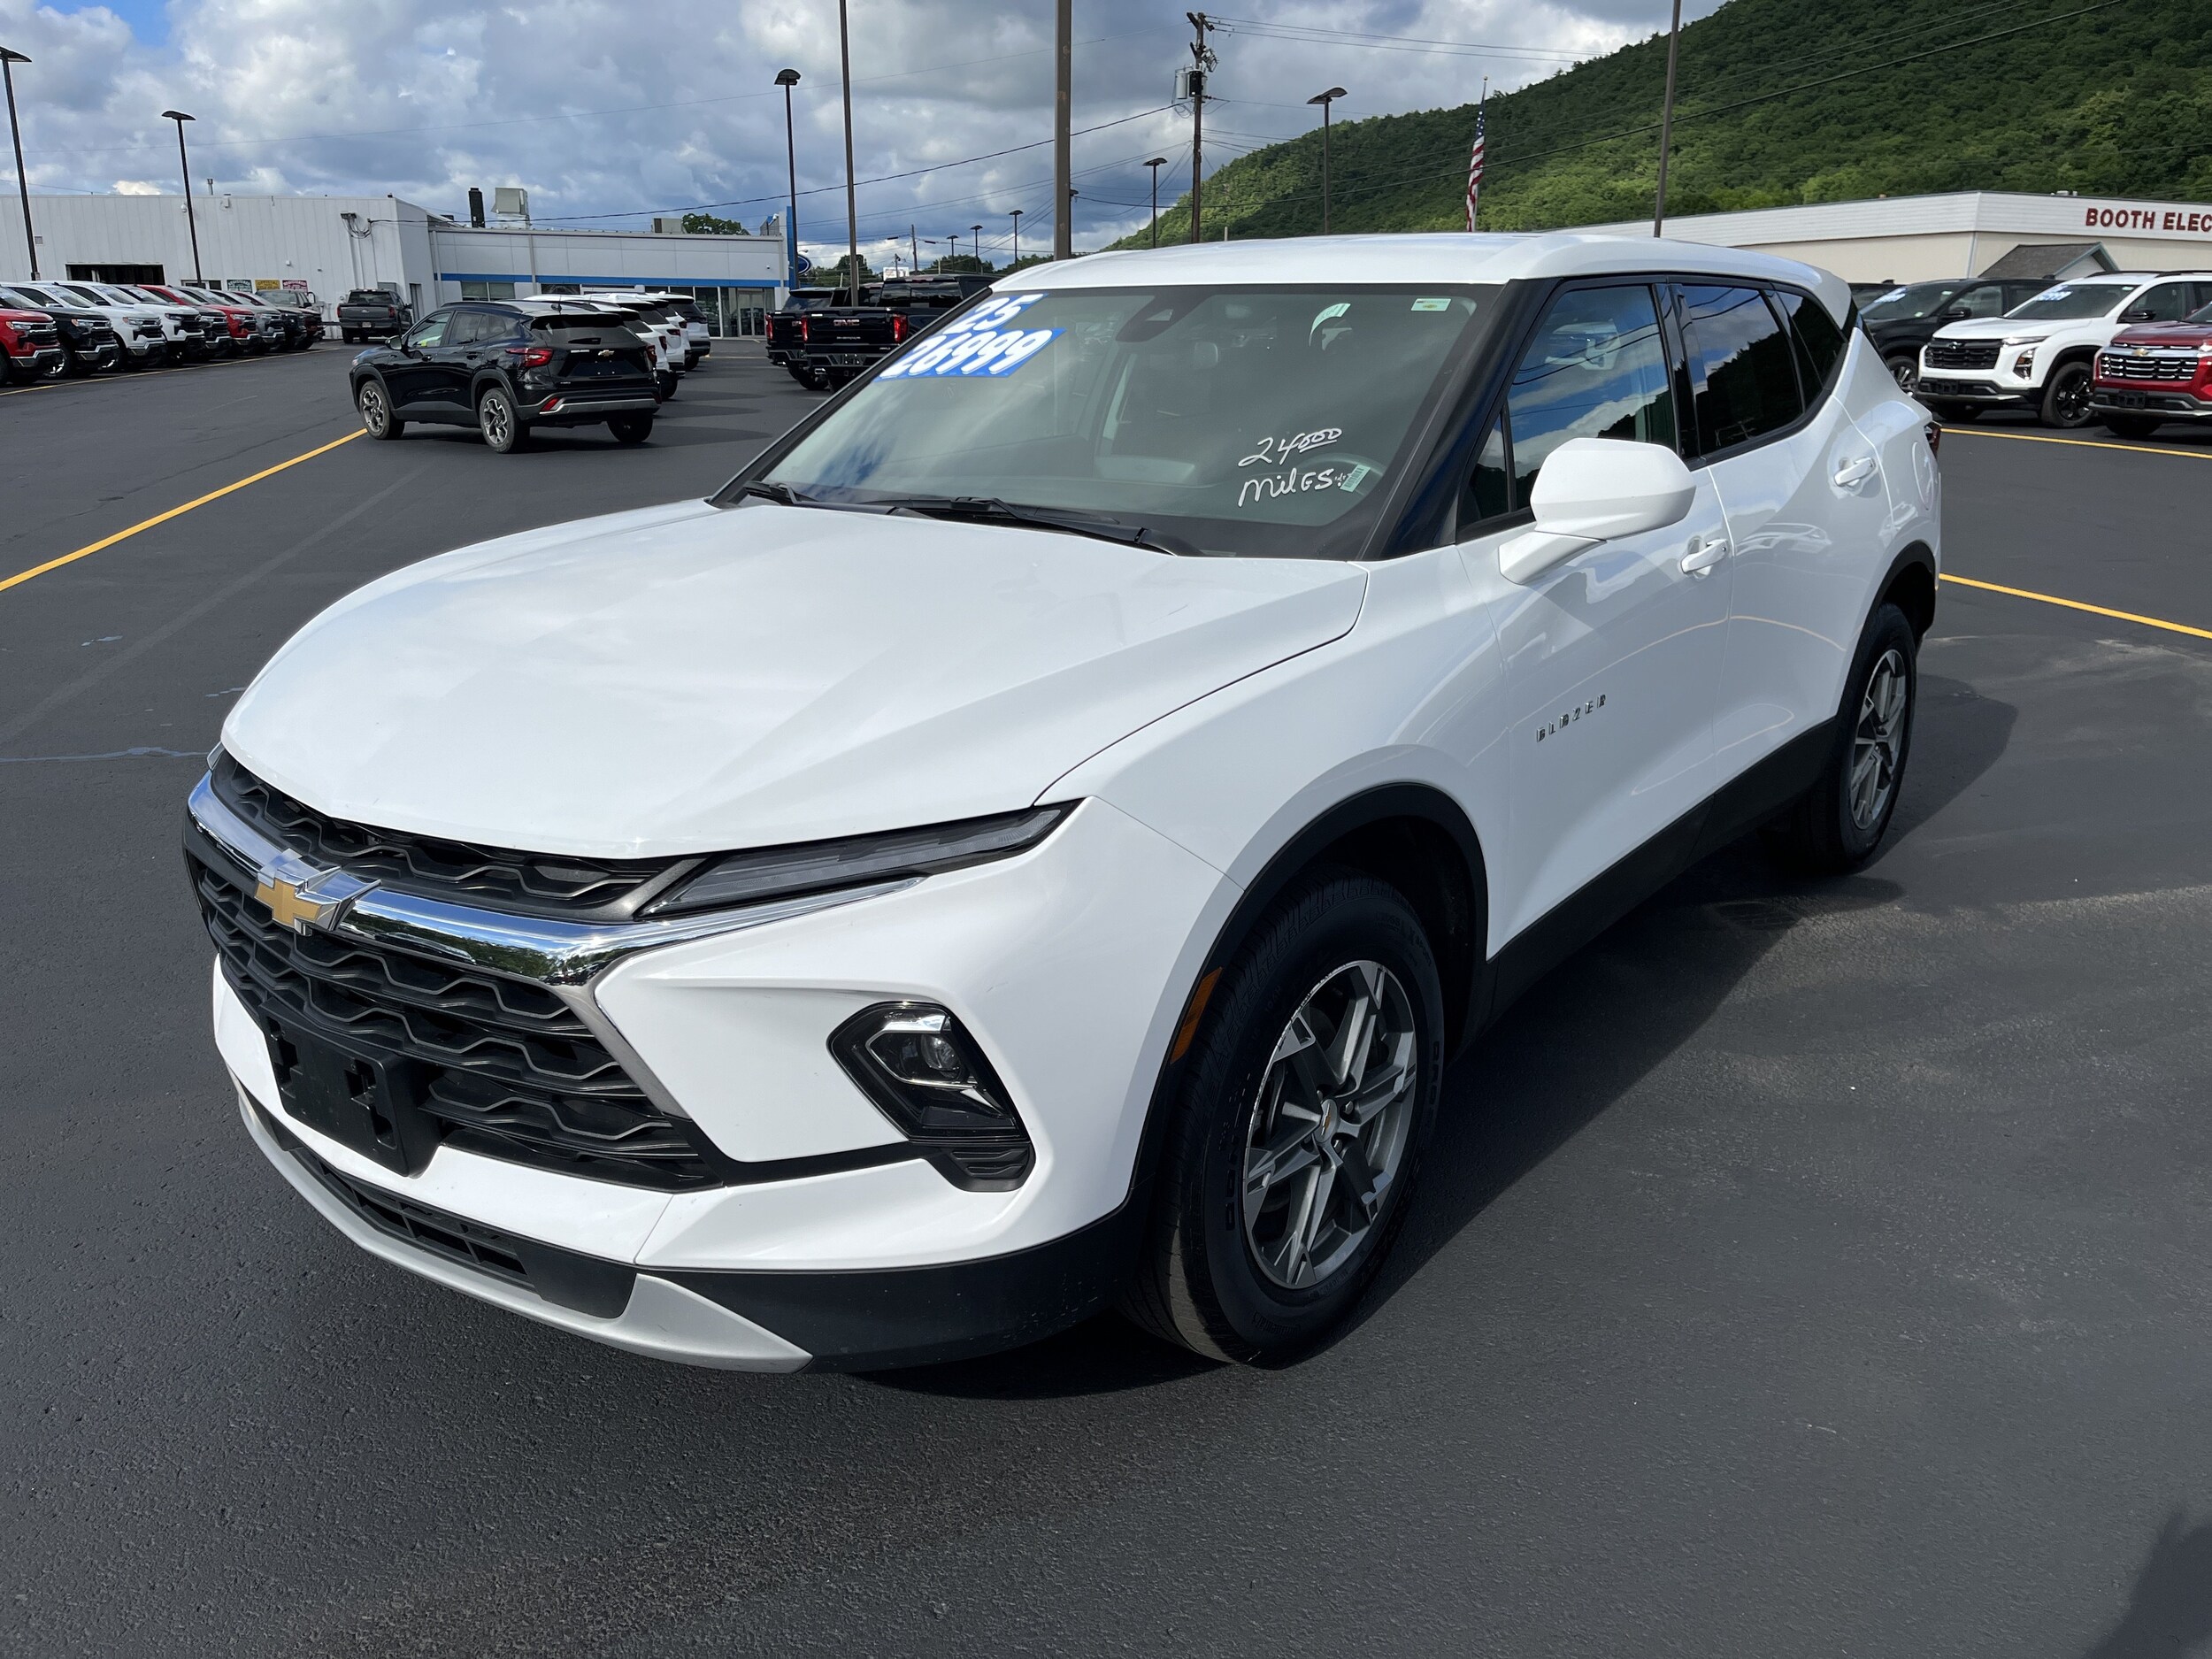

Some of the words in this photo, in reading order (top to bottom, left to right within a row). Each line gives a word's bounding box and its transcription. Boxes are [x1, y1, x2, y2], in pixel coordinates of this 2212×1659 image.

[2085, 207, 2156, 230] BOOTH
[2162, 211, 2212, 233] ELEC
[942, 293, 1043, 334] 25
[879, 329, 1053, 379] 26999
[1536, 694, 1607, 742] BLAZER
